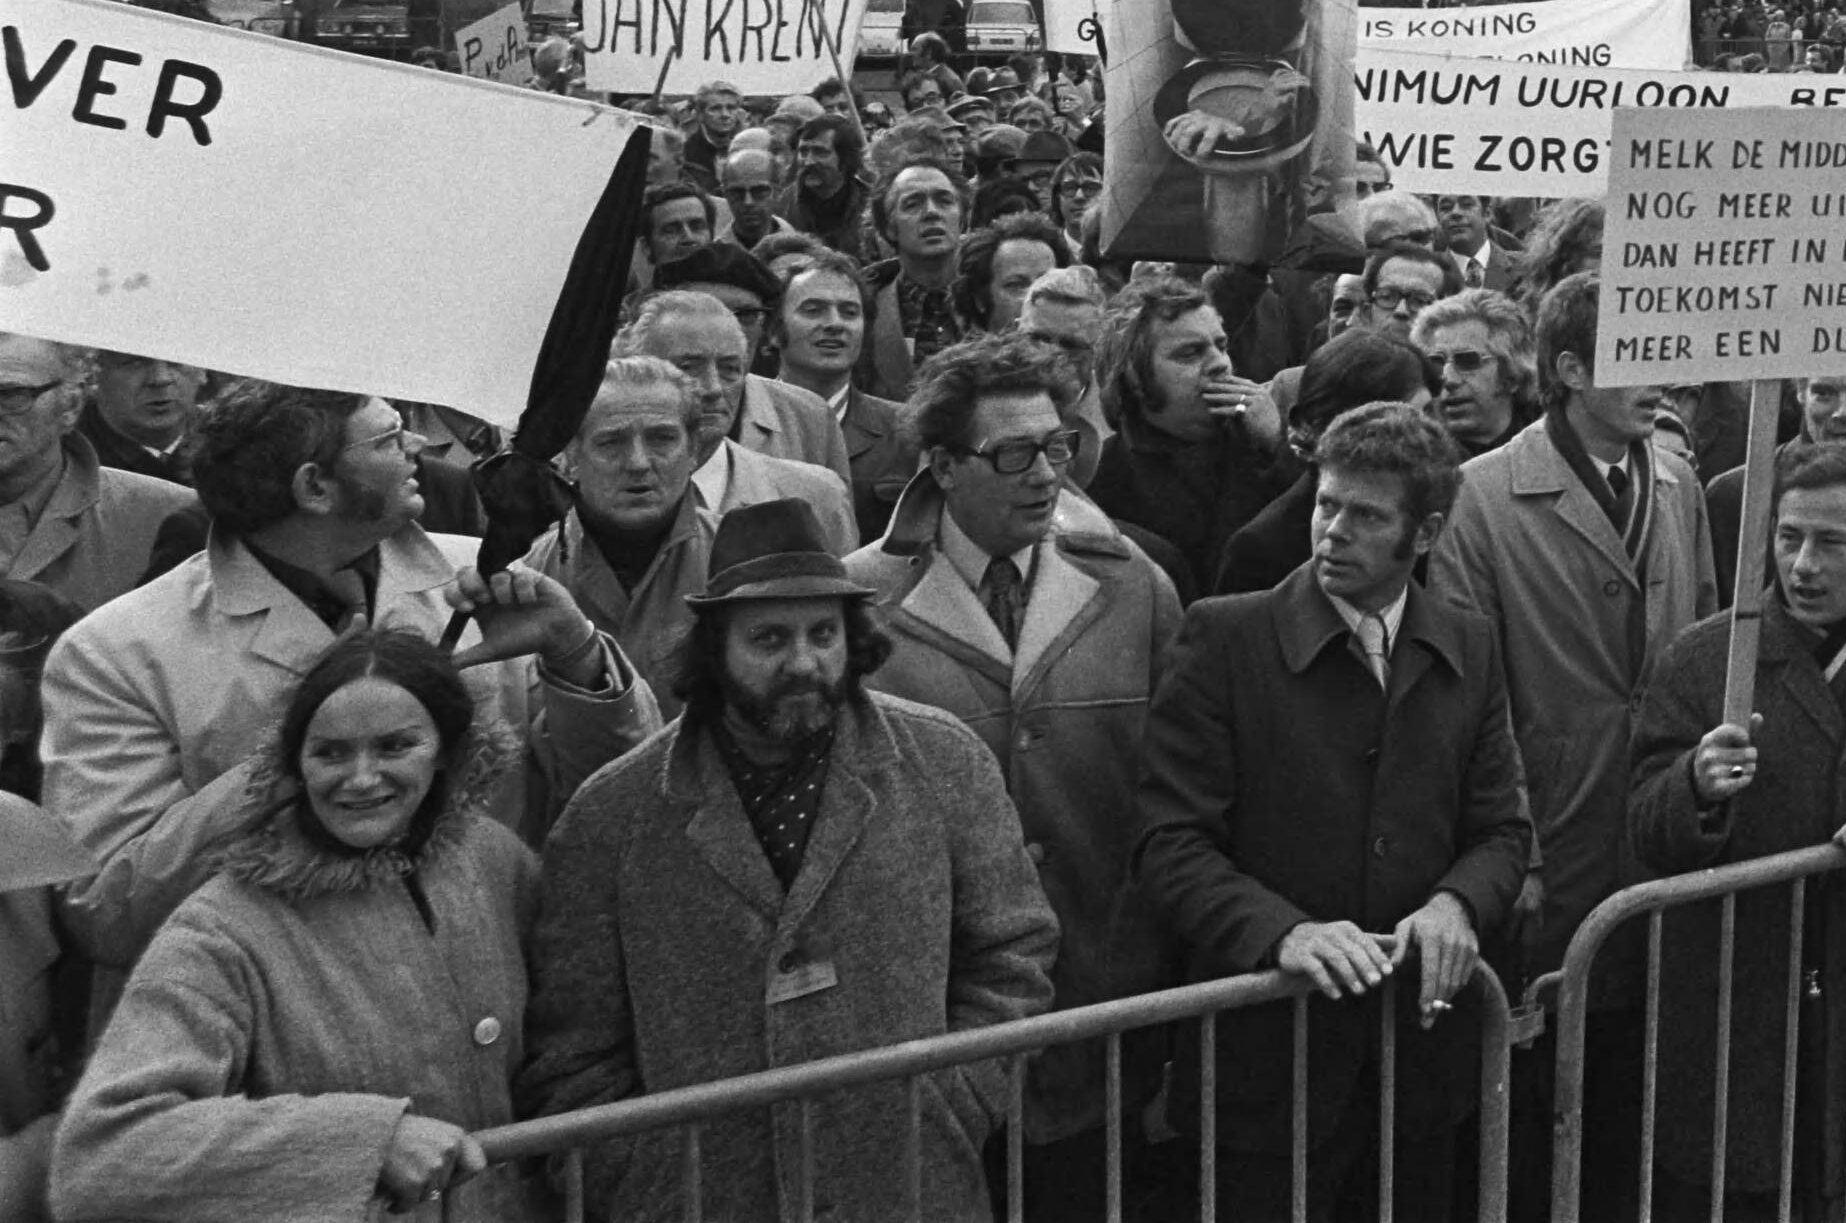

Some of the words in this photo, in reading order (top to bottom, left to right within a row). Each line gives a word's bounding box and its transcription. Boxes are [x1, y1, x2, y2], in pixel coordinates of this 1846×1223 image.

[1365, 21, 1394, 37] IS
[1407, 12, 1536, 37] KONING
[2, 25, 223, 146] VER
[1518, 75, 1730, 109] UURLOON
[1363, 131, 1455, 169] WIE
[1474, 135, 1611, 174] ZORG
[1630, 139, 1712, 170] MELK
[1732, 141, 1766, 170] DE
[1626, 192, 1697, 220] NOG
[1718, 193, 1791, 218] MEER
[1624, 241, 1679, 269] DAN
[1694, 239, 1776, 266] HEEFT
[1792, 239, 1826, 263] IN
[1616, 284, 1778, 313] TOEKOMST
[1616, 335, 1693, 363] MEER
[1716, 329, 1781, 358] EEN
